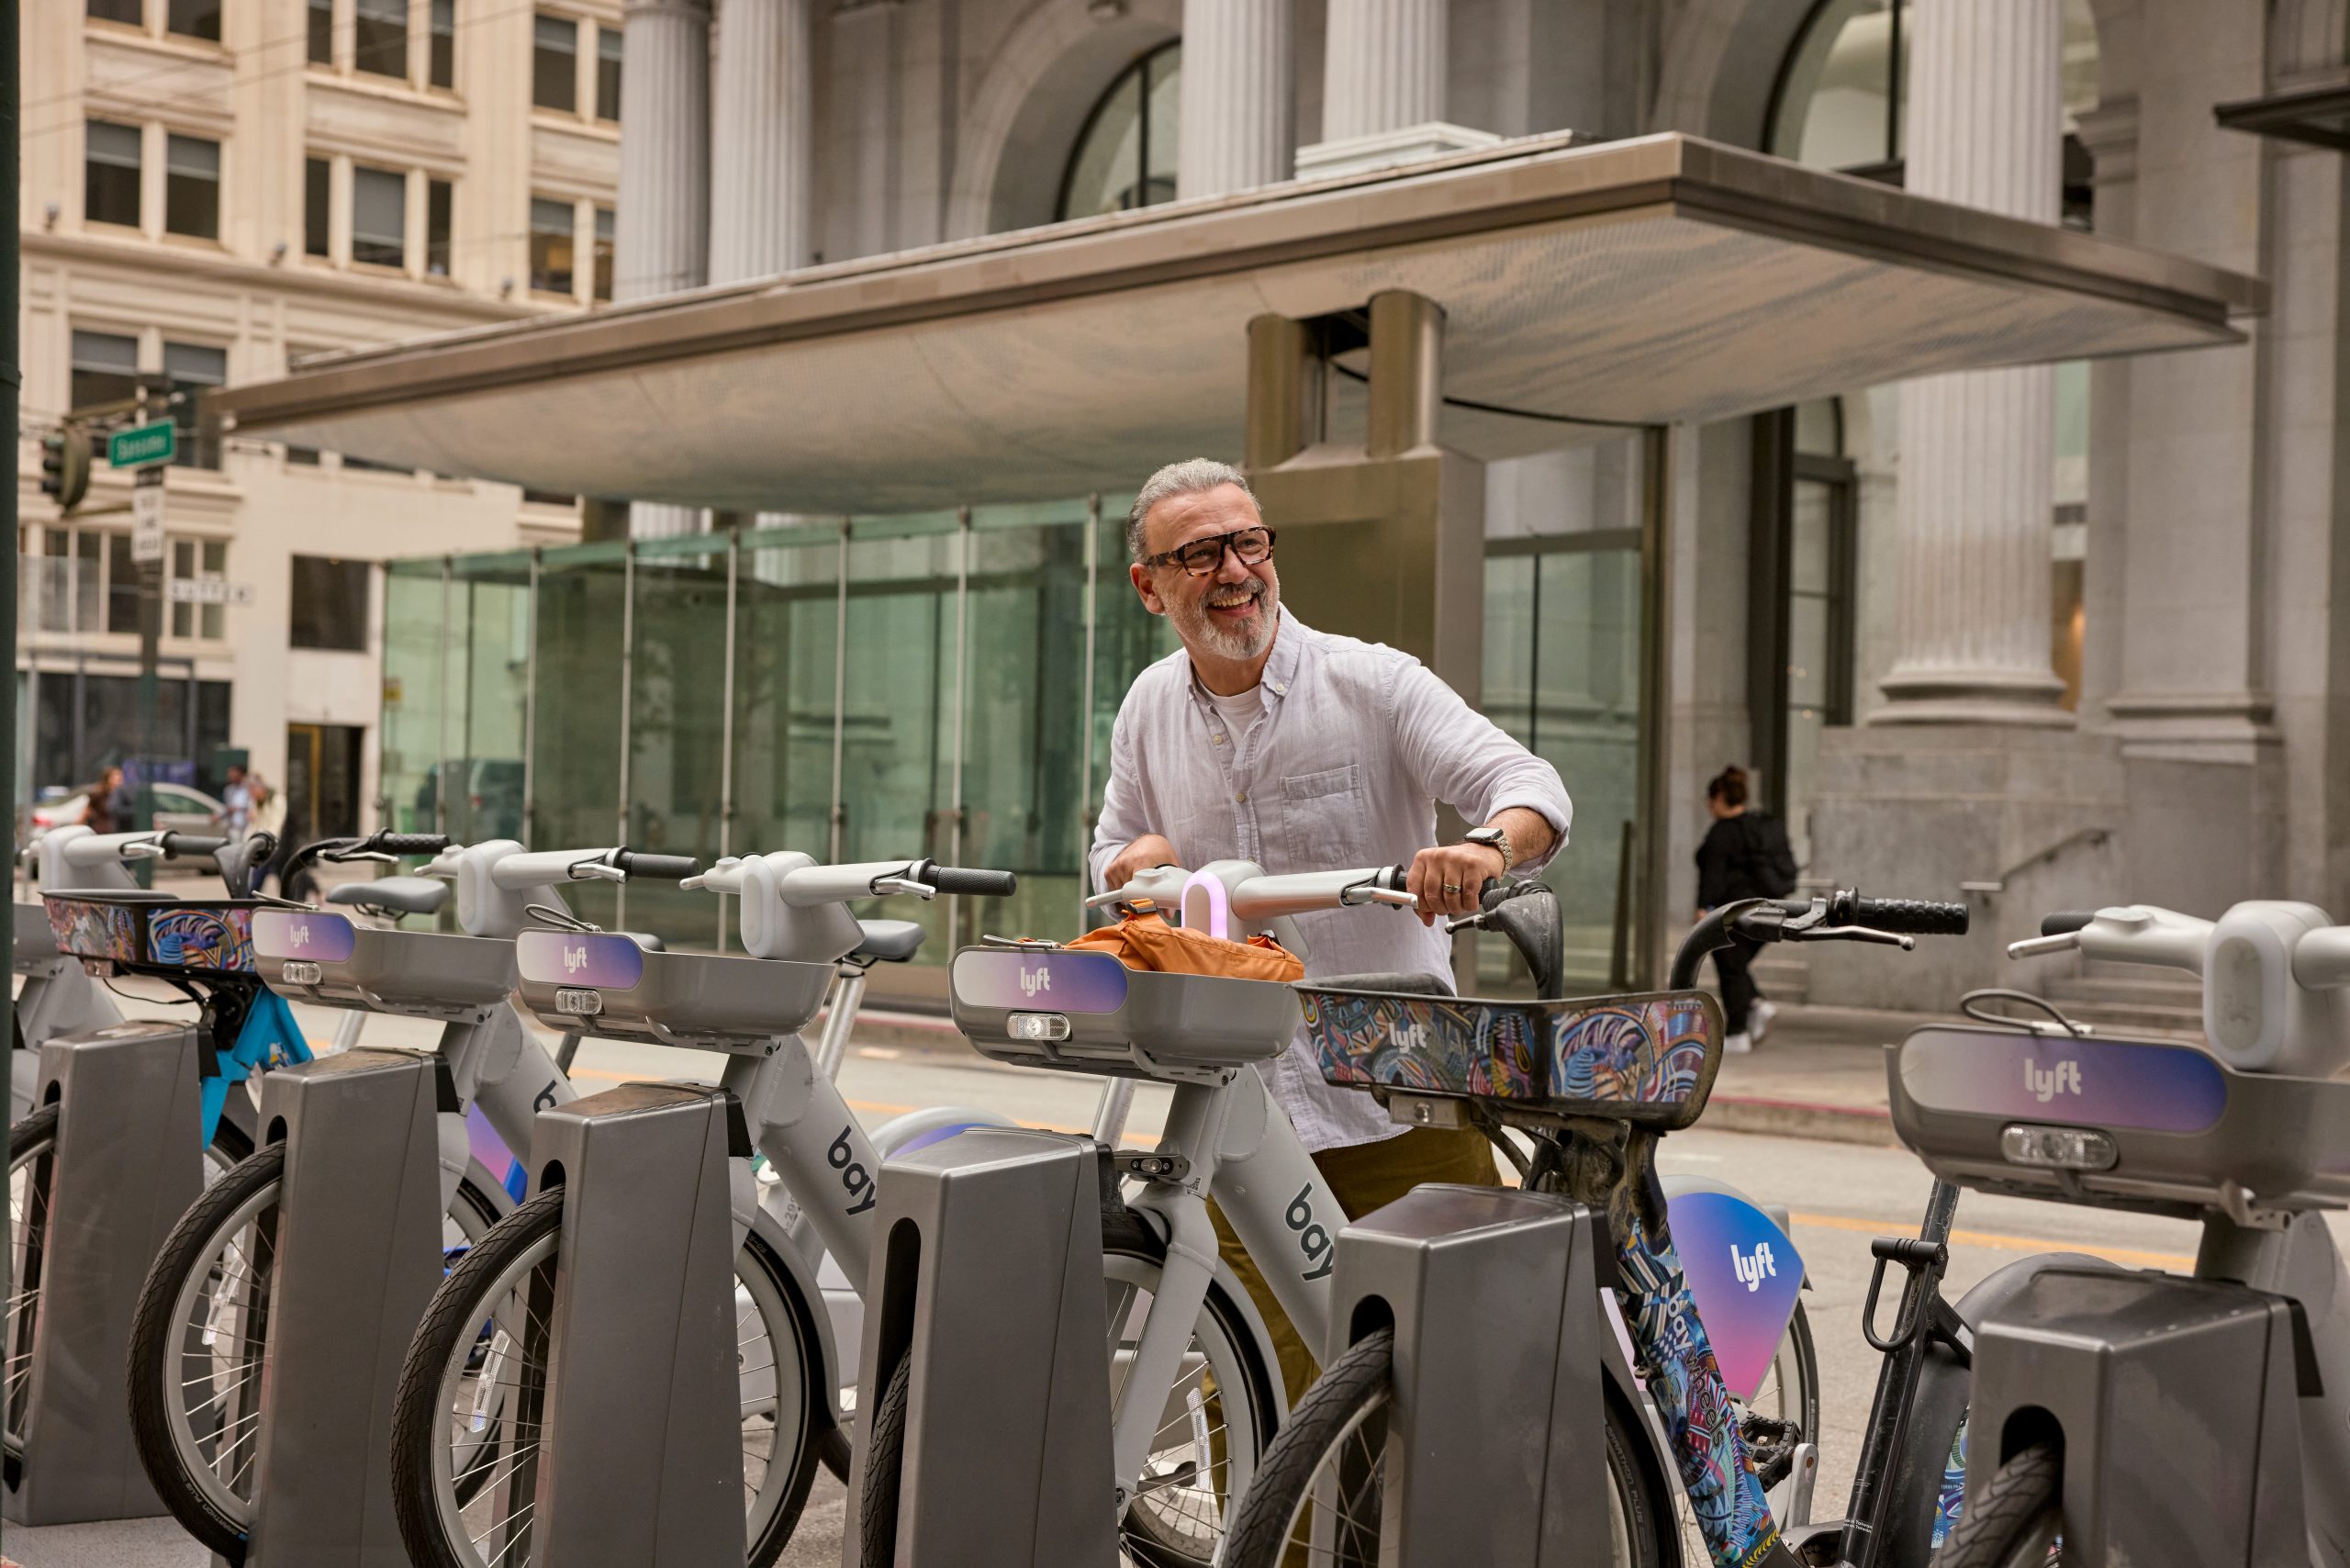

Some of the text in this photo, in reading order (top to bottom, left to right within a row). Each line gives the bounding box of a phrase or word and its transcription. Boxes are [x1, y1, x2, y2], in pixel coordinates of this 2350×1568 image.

[290, 924, 309, 948] lyft
[564, 946, 588, 974] lyft
[1020, 966, 1050, 998] lyft
[1388, 1022, 1427, 1054] lyft
[2024, 1057, 2082, 1103] lyft
[827, 1125, 876, 1216] bay
[1285, 1182, 1334, 1282] bay
[1729, 1241, 1777, 1293] lyft
[1667, 1290, 1726, 1450] bay wheels
[1630, 1490, 1644, 1523] PLUS
